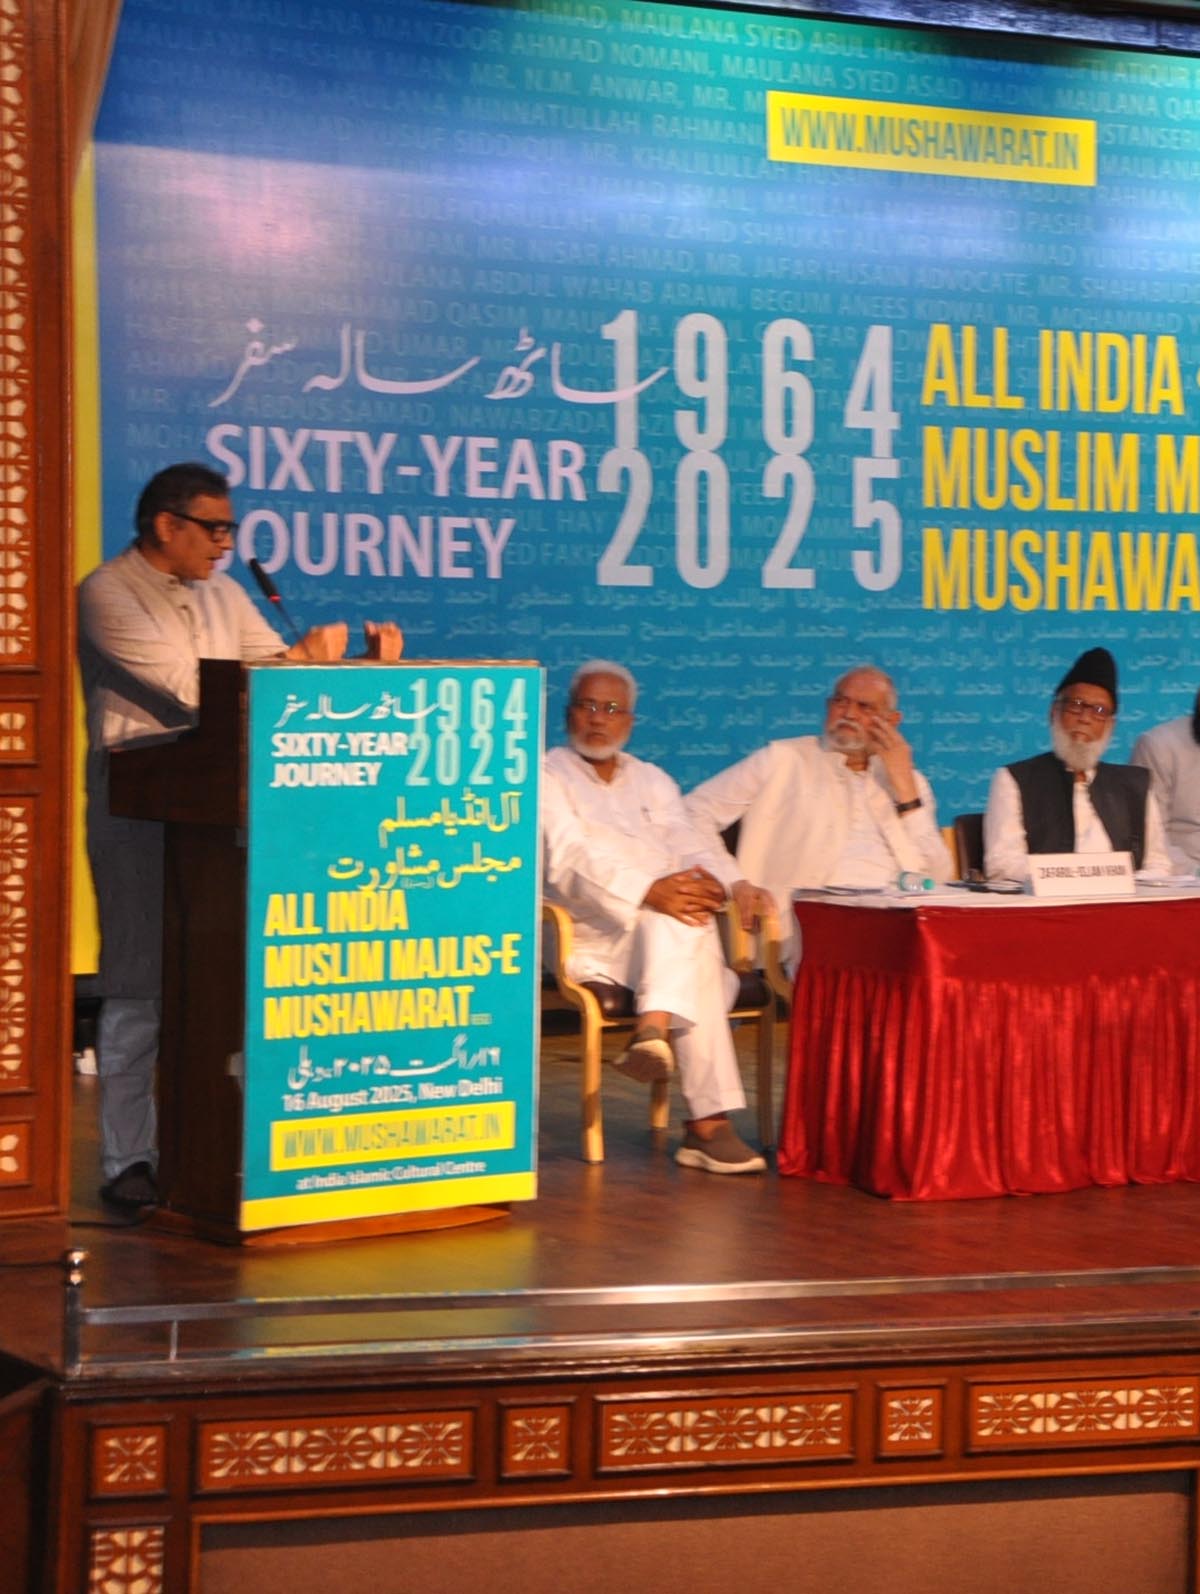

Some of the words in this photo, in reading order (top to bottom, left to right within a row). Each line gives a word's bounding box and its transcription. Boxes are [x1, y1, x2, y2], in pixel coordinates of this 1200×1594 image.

[372, 14, 503, 50] MANZOOR
[511, 31, 603, 63] AHMAD
[720, 54, 836, 89] MAULANA
[842, 67, 899, 95] SYED
[746, 24, 799, 51] SYED
[470, 61, 515, 89] MR.
[781, 107, 1080, 170] WWW.MUSHAWARAT.IN
[529, 238, 599, 265] NISAR
[752, 255, 819, 282] JAFAR
[665, 215, 738, 243] ZAHID
[743, 220, 846, 250] SHAUKAT
[941, 237, 1076, 267] MOHAMMAD
[1080, 245, 1150, 271] YUNUS
[472, 268, 556, 298] ABDUL
[563, 275, 651, 303] WAHAB
[752, 288, 831, 314] BEGUM
[1052, 305, 1182, 332] MOHAMMAD
[601, 309, 901, 456] 1964
[920, 323, 1024, 410] ALL
[1039, 329, 1185, 416] INDIA
[206, 423, 587, 501] SIXTY-YEAR
[922, 425, 1139, 513] MUSLIM
[216, 509, 516, 580] OURNEY
[597, 448, 903, 591] 2025
[409, 677, 529, 733] 1964
[270, 731, 410, 758] SIXTY-YEAR
[405, 730, 529, 786] 2025
[268, 761, 383, 788] JOURNEY
[327, 843, 440, 891] مشاورت
[437, 841, 522, 889] مجلس
[263, 892, 323, 937] ALL
[327, 888, 410, 934] INDIA
[263, 939, 385, 989] MUSLIM
[389, 933, 522, 981] MAJLIS-E
[263, 985, 475, 1041] MUSHAWARAT
[281, 1092, 306, 1112] 16
[306, 1089, 369, 1113] August
[369, 1083, 417, 1104] 2025,
[418, 1082, 457, 1101] New
[457, 1076, 504, 1096] Delhi
[282, 1112, 502, 1160] WWW.MUSHAWARAT.IN
